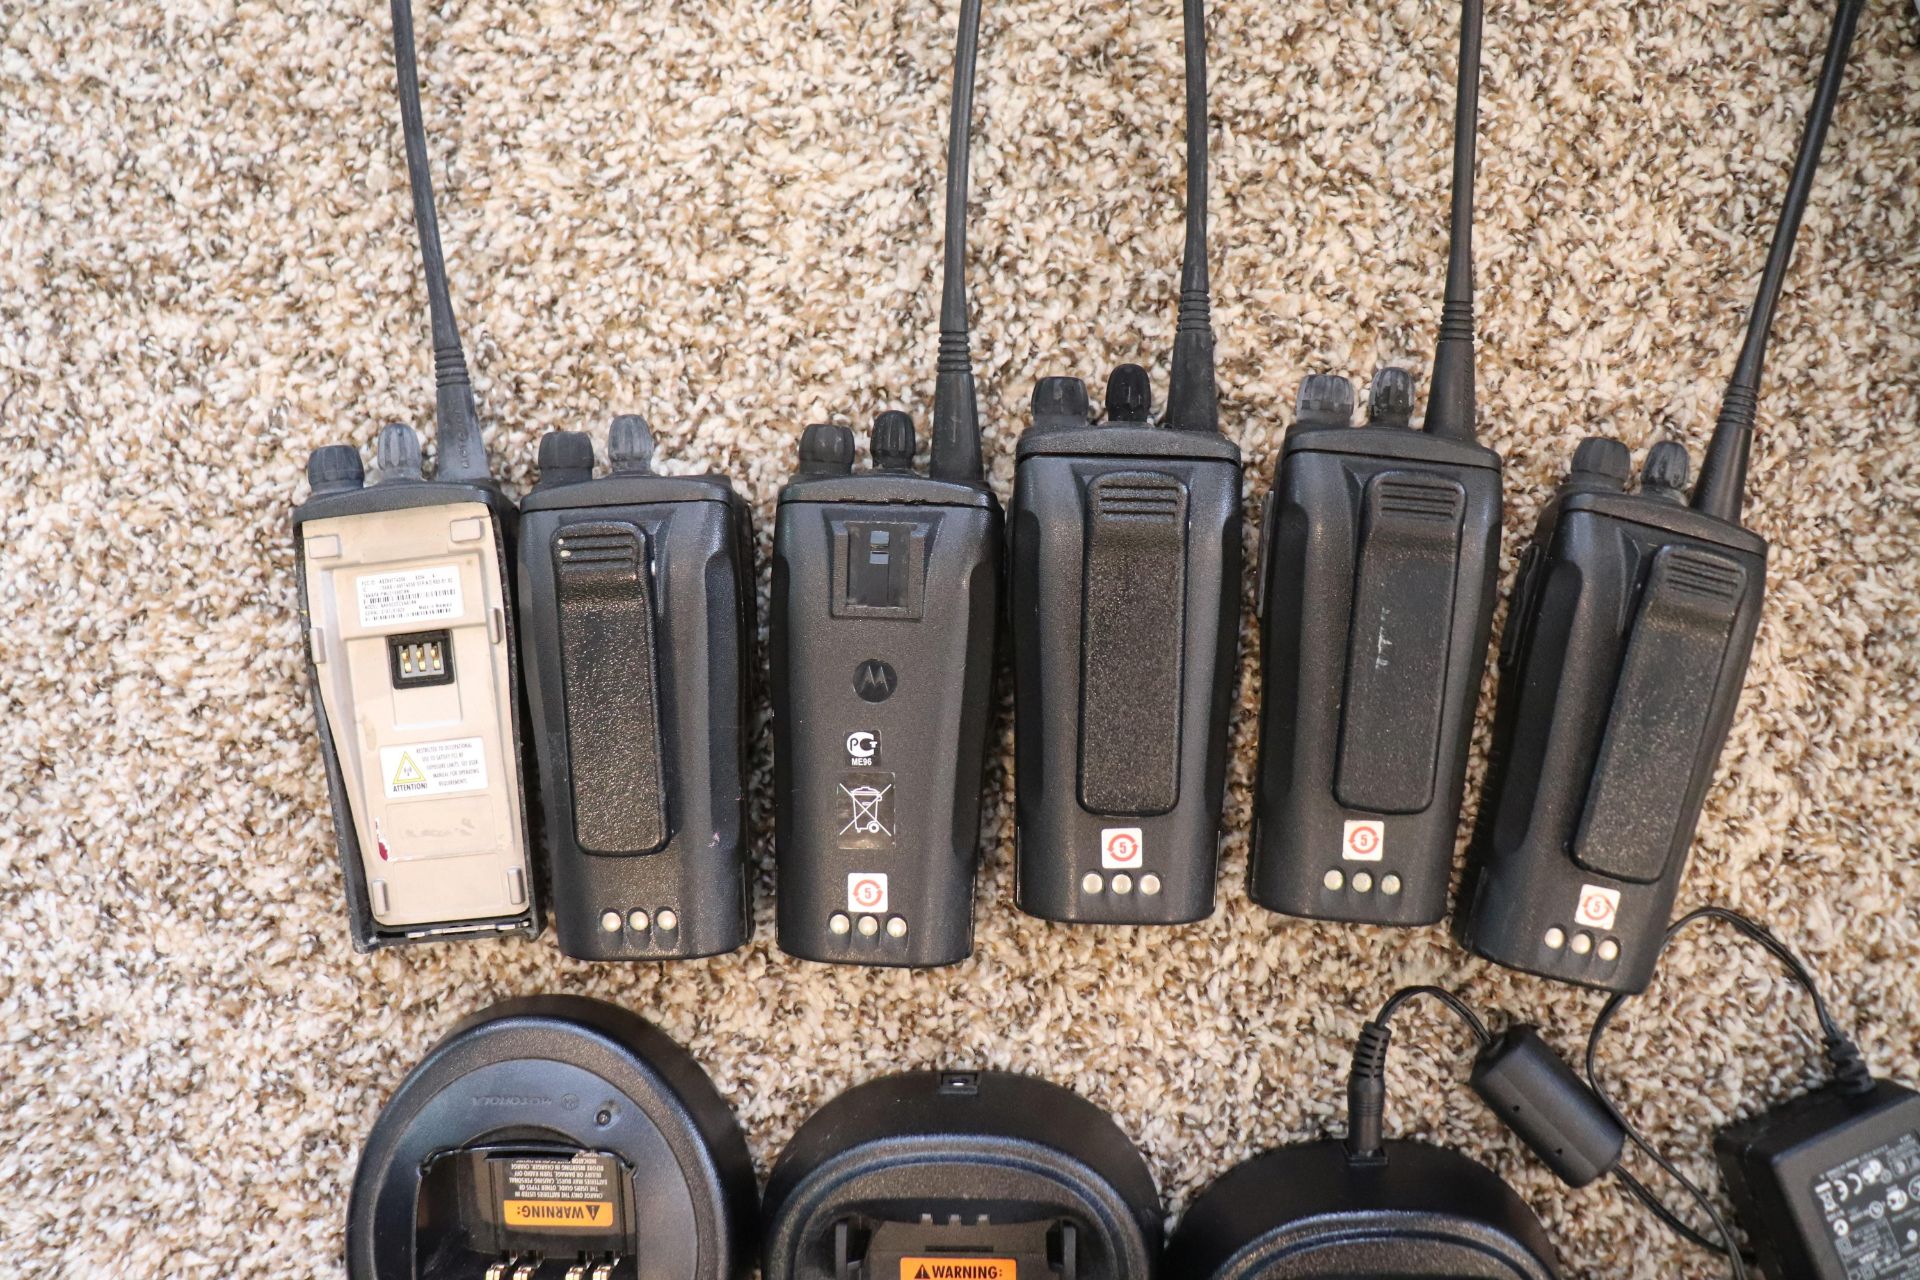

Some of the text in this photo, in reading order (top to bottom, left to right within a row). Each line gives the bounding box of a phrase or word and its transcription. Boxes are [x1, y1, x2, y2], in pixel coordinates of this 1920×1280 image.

[851, 757, 873, 766] ME96
[393, 783, 428, 792] ATTENTION!
[1360, 834, 1368, 846] 5
[1119, 842, 1126, 854] 5
[864, 887, 872, 899] 5
[1593, 901, 1602, 913] 5
[517, 1205, 584, 1219] WARNING:
[932, 1264, 1002, 1279] WARNING:
